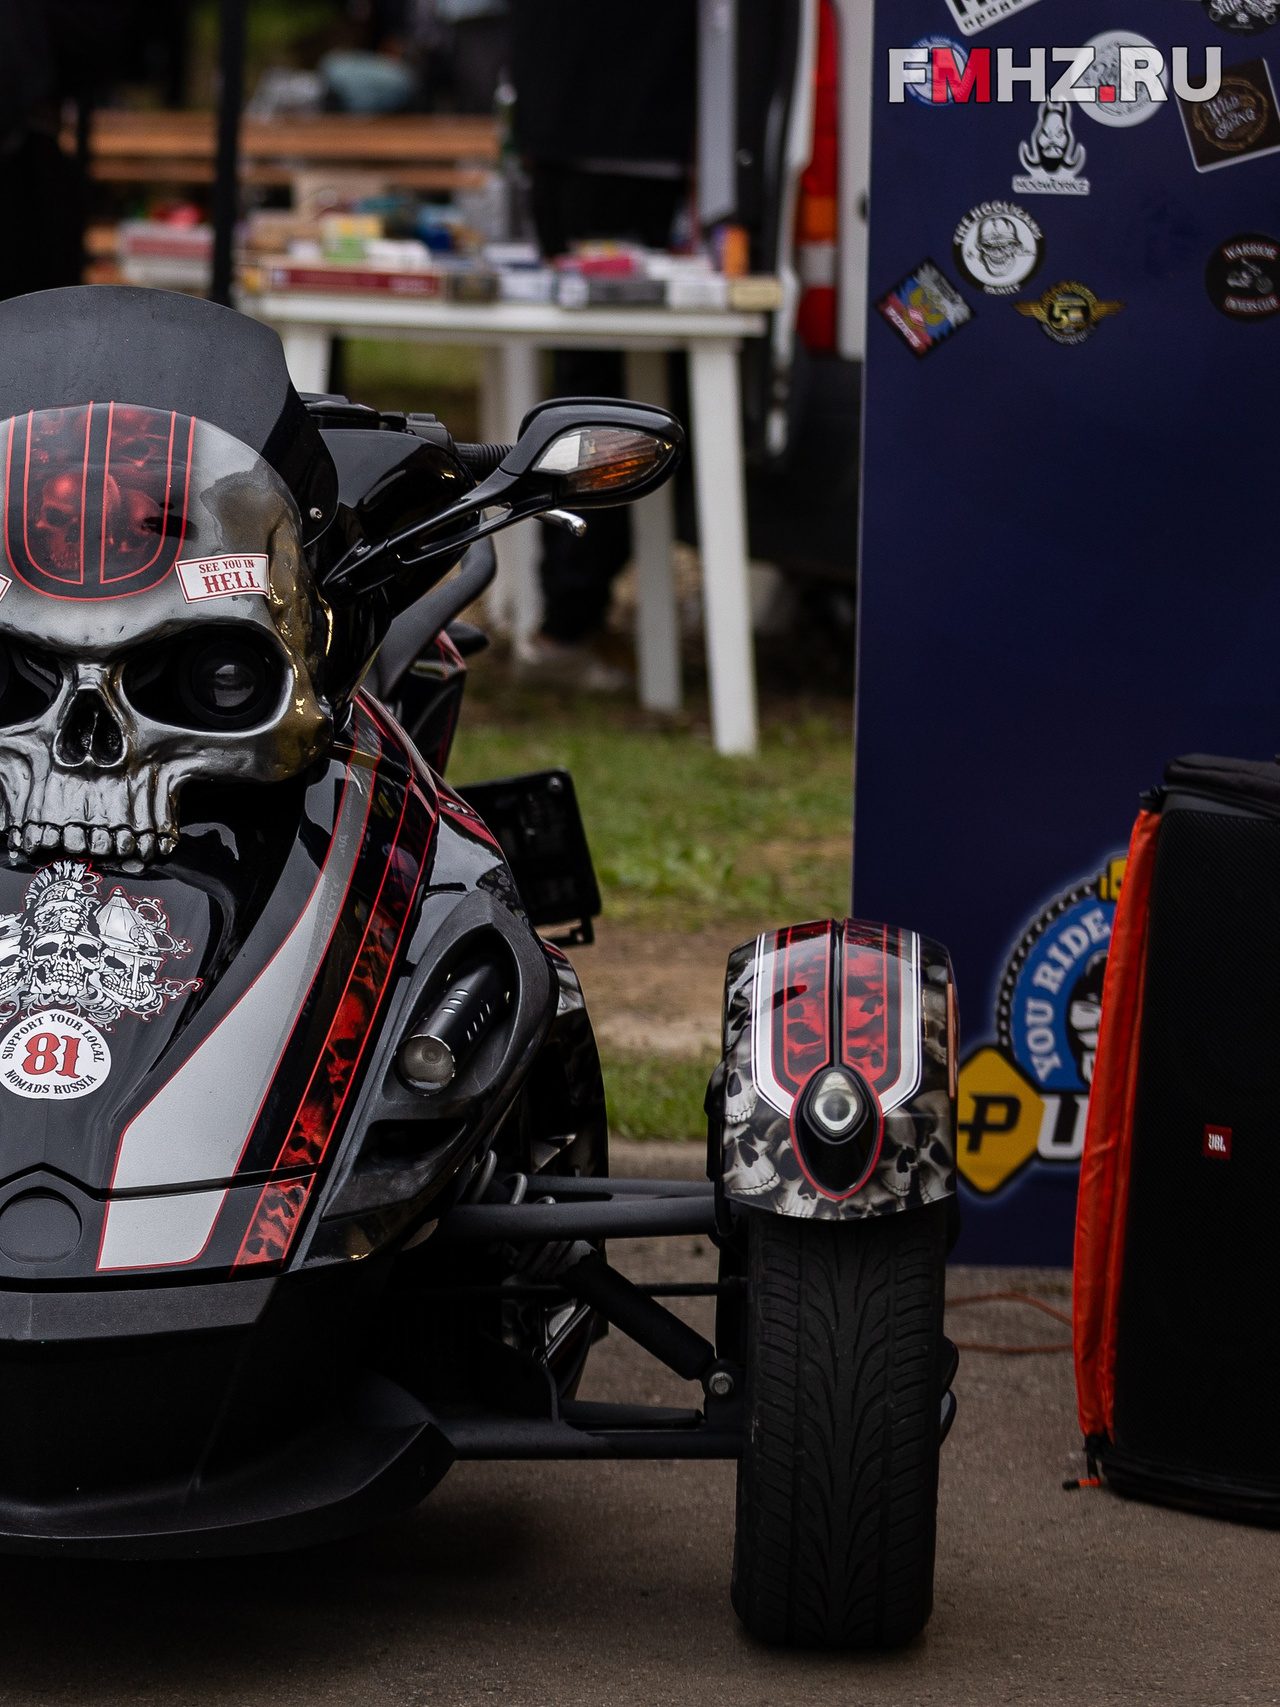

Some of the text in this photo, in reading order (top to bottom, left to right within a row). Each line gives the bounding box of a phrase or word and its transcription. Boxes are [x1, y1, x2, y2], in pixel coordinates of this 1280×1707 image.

[198, 559, 255, 574] SEE YOU IN
[202, 570, 262, 594] HELL
[1025, 908, 1111, 1081] YOU RIDE
[2, 1013, 105, 1062] SUPPORT YOUR LOCAL
[21, 1032, 81, 1080] 81
[4, 1069, 98, 1095] NOMADS RUSSIA
[1207, 1133, 1227, 1152] JBL
